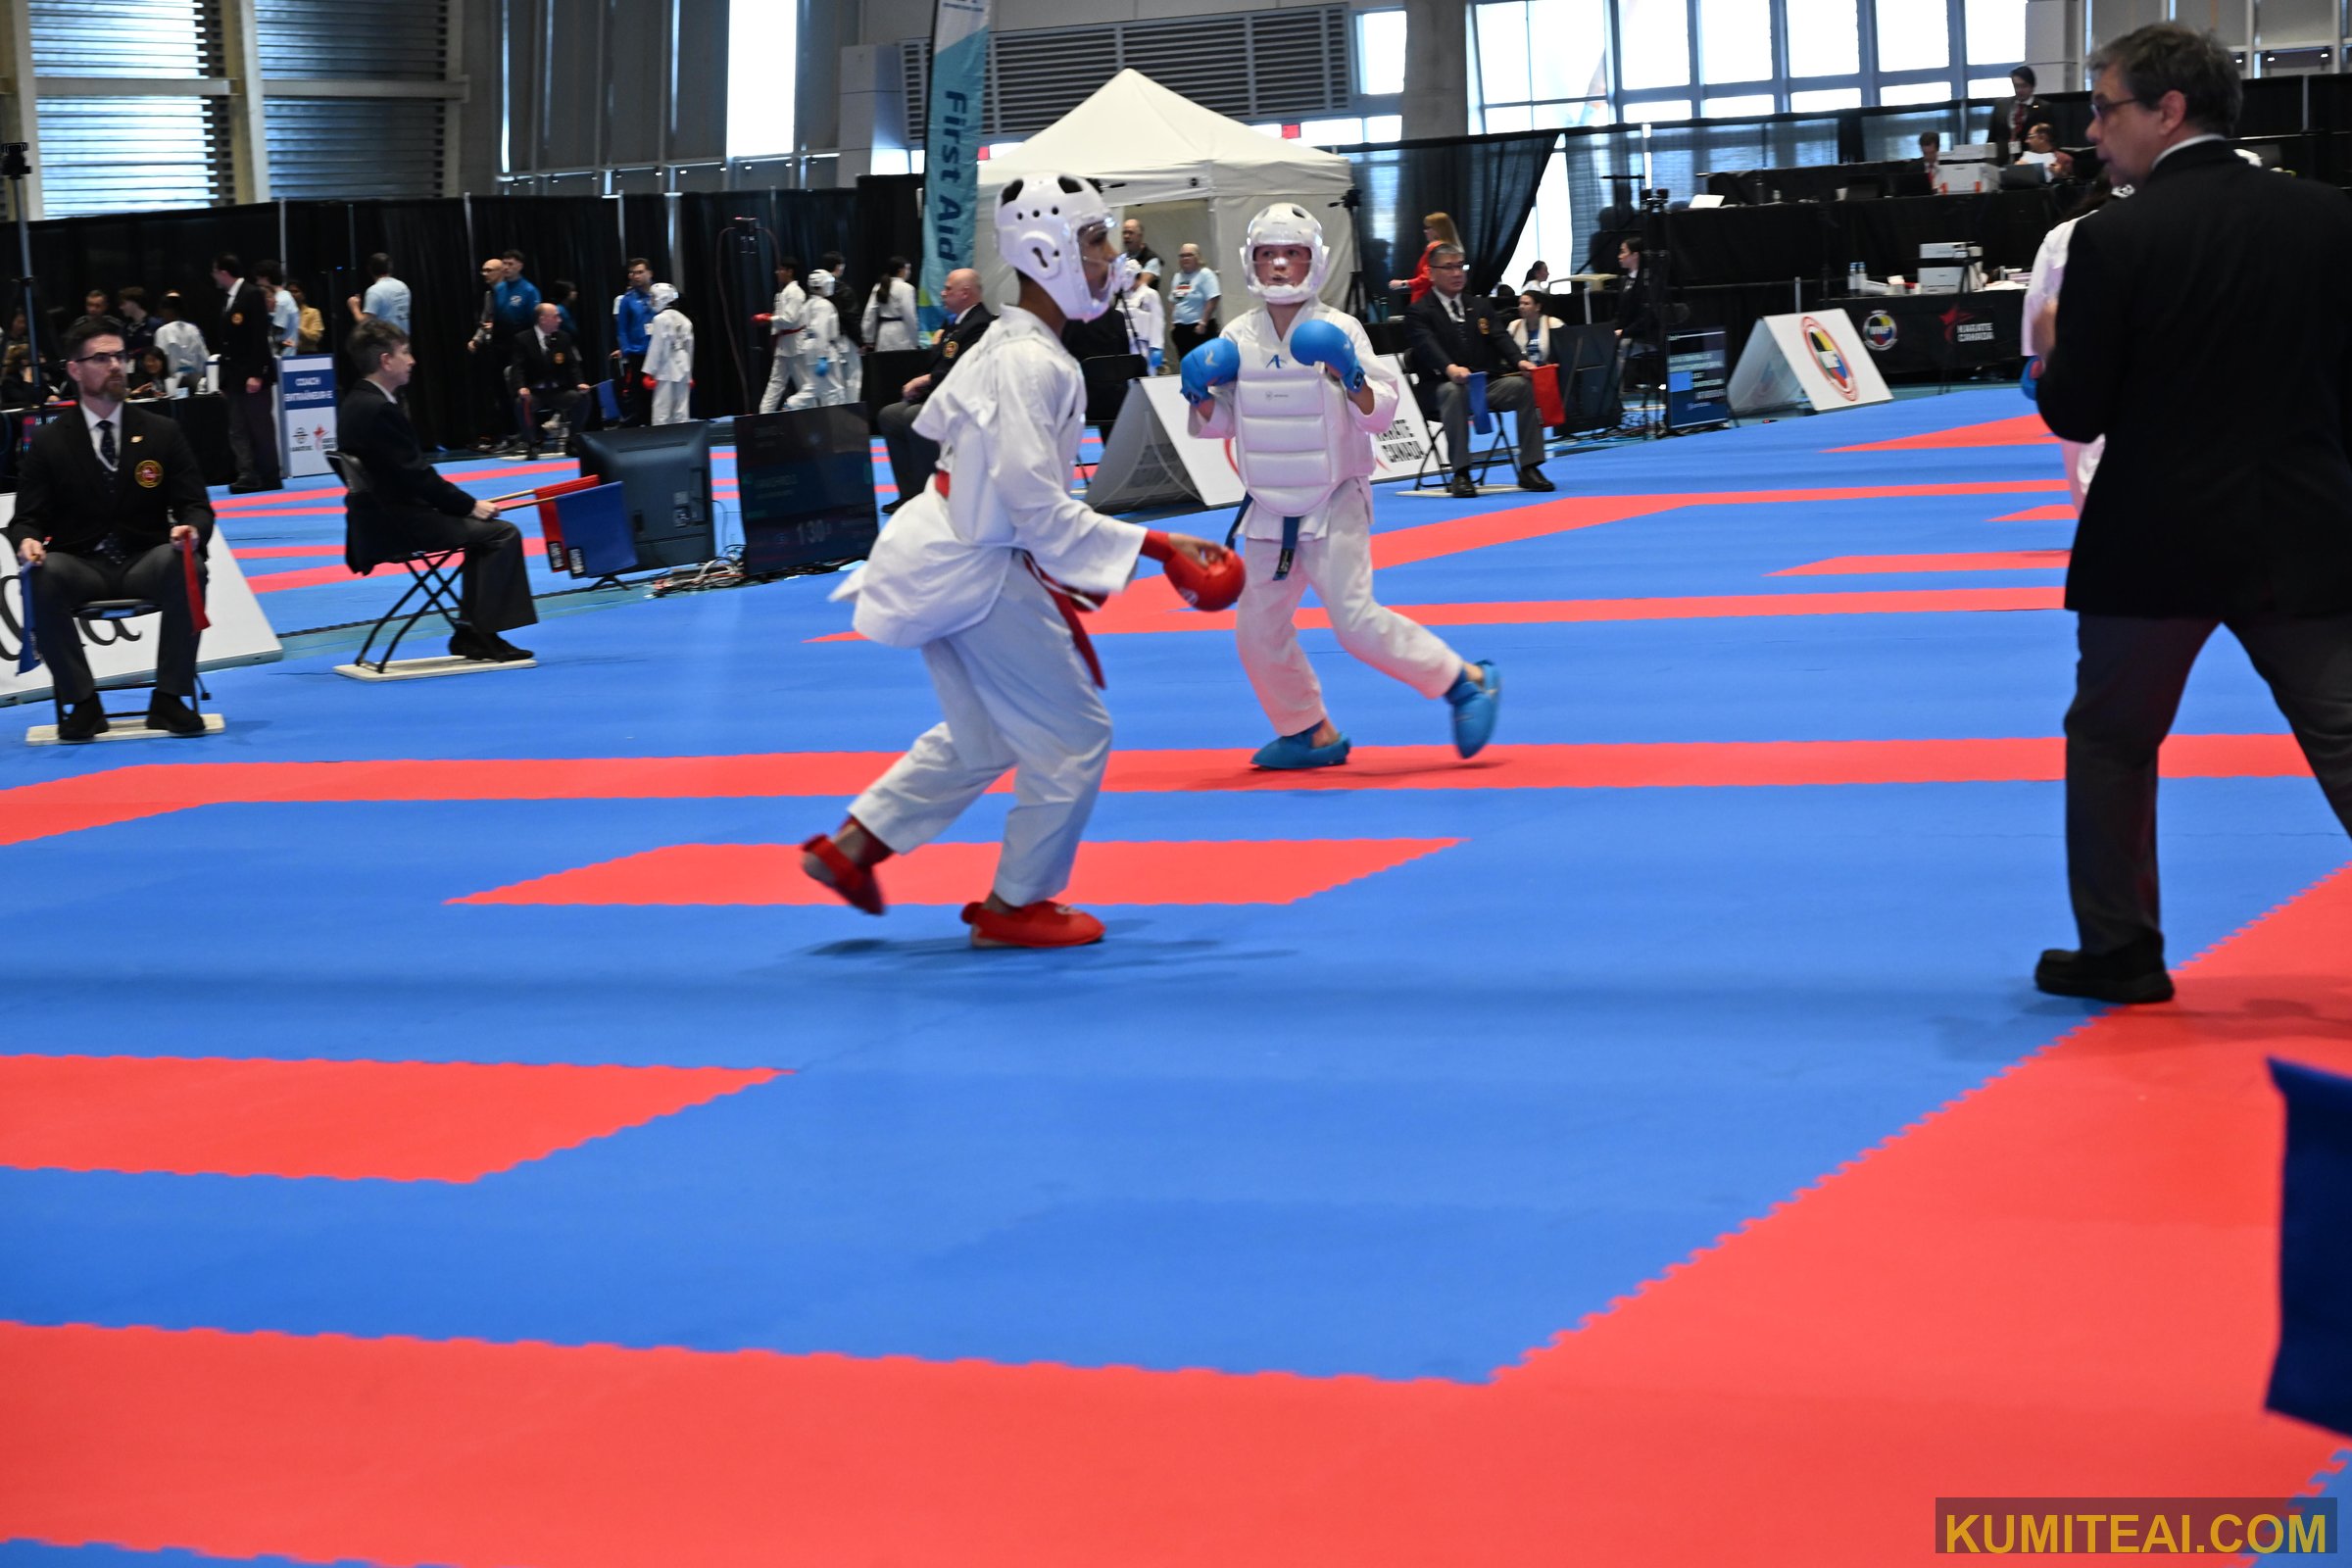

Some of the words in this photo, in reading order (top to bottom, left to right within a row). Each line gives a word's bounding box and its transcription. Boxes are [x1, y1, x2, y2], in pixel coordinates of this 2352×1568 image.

[941, 90, 966, 183] First
[938, 195, 960, 262] Aid
[1956, 322, 1993, 333] KARATE
[1957, 331, 1994, 342] CANADA
[295, 376, 321, 386] COACH
